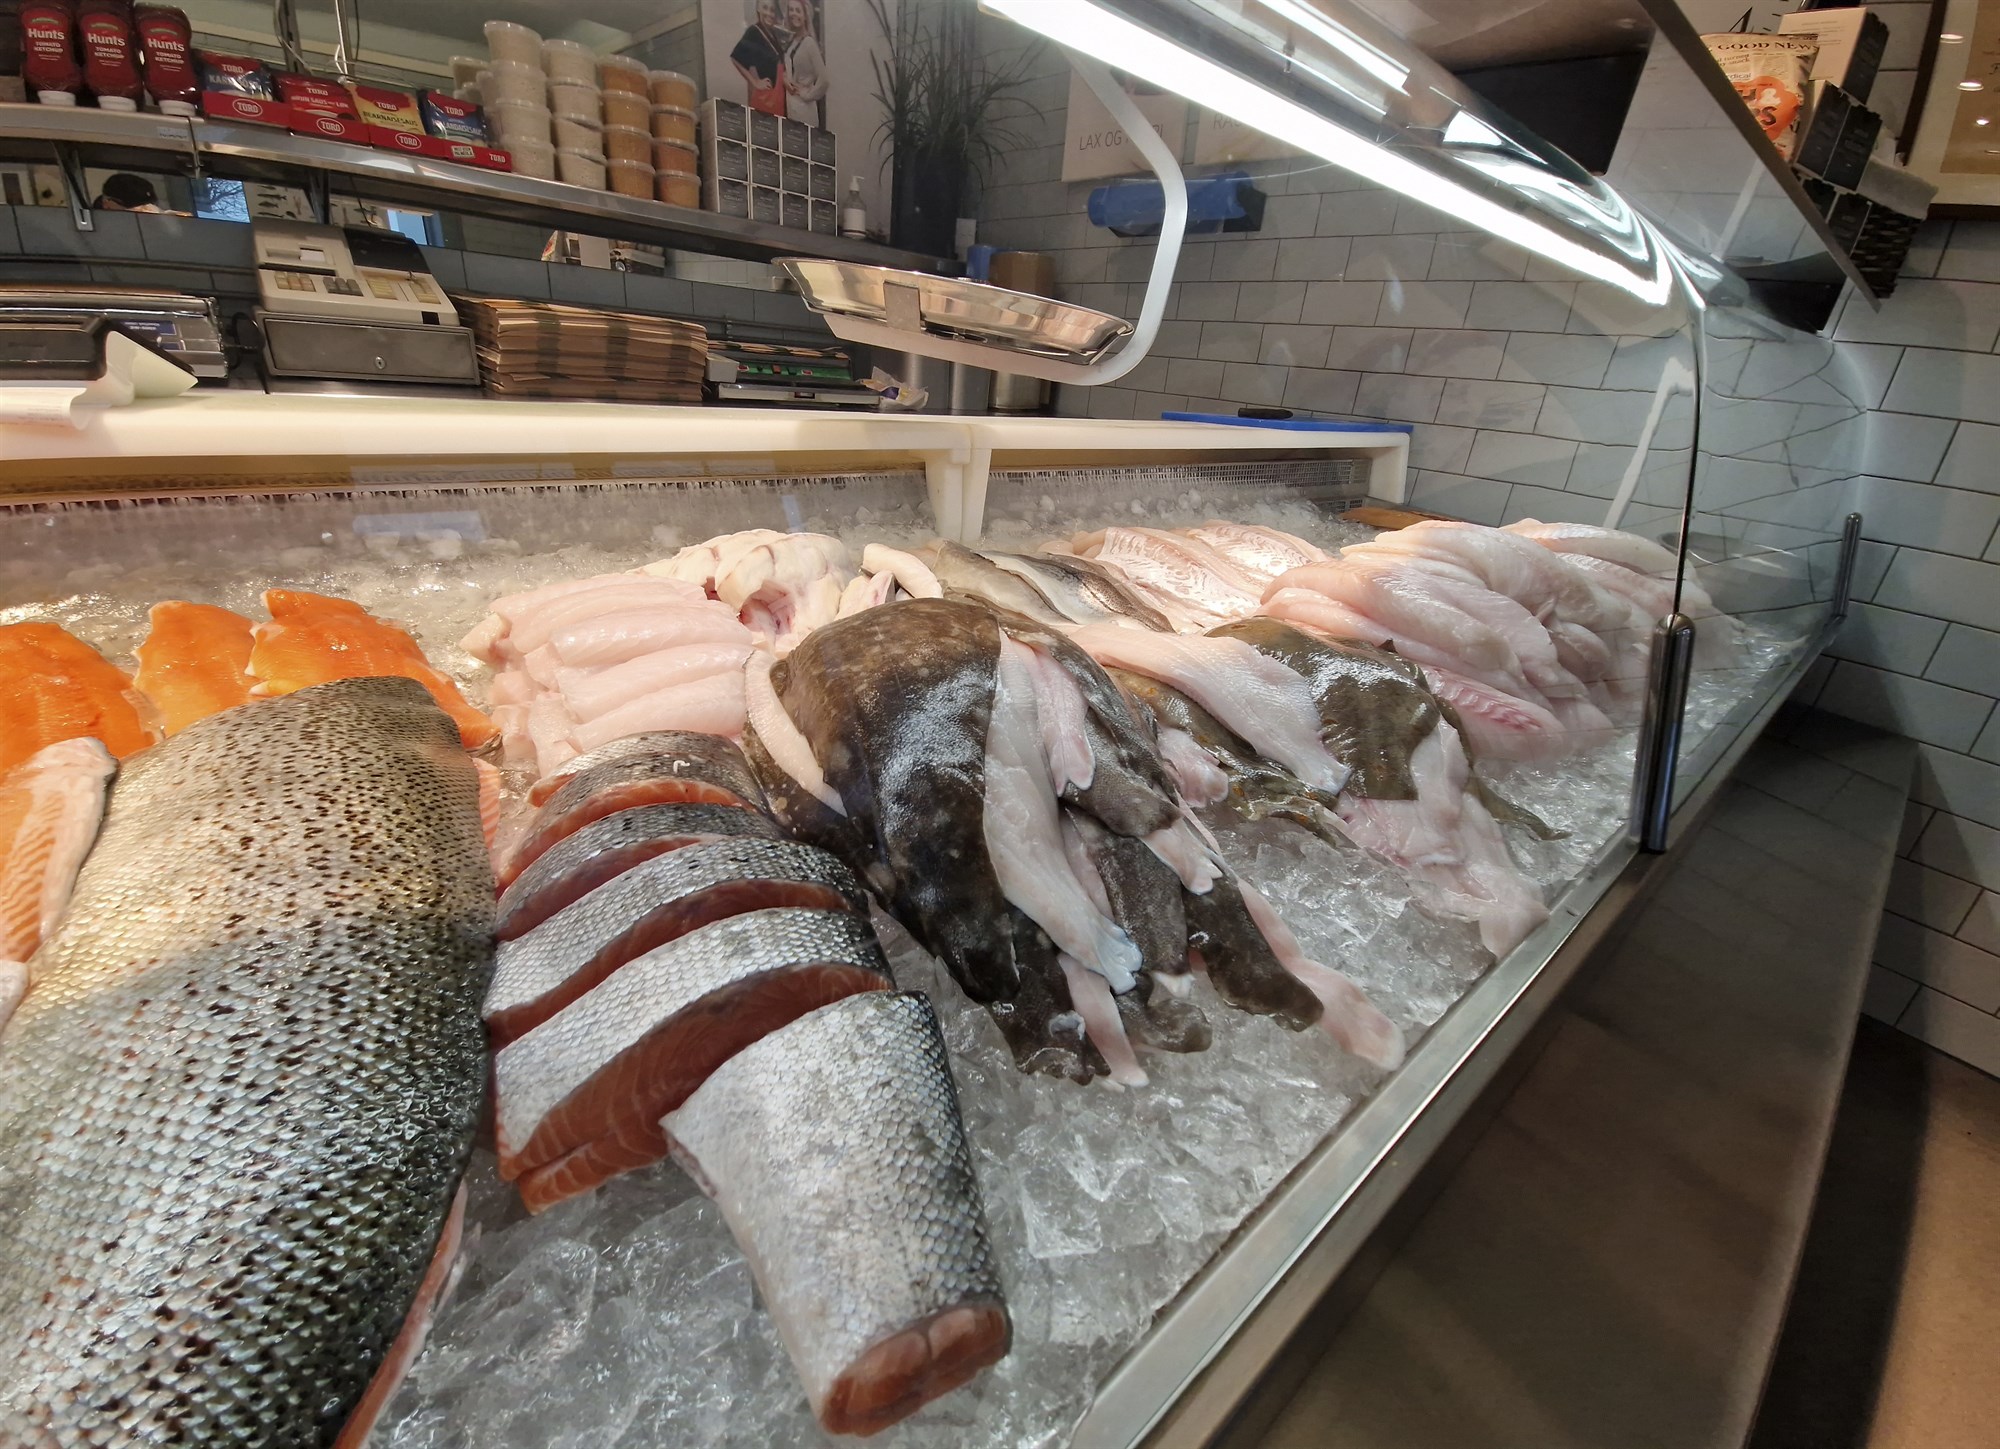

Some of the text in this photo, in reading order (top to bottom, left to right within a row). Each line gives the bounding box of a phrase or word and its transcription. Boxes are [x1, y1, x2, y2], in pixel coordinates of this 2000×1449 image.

[28, 28, 65, 40] Hunts
[87, 33, 126, 46] Hunts
[147, 38, 185, 52] Hunts
[1717, 42, 1770, 50] GOOD
[222, 64, 244, 73] TORO
[306, 87, 329, 96] TORO
[237, 102, 259, 113] TORO
[376, 101, 397, 111] TORO
[444, 106, 464, 116] TORO
[320, 121, 341, 132] TORO
[398, 135, 418, 146] TORO
[1079, 131, 1102, 151] LAX
[1104, 130, 1122, 147] OG
[489, 153, 506, 163] TORO
